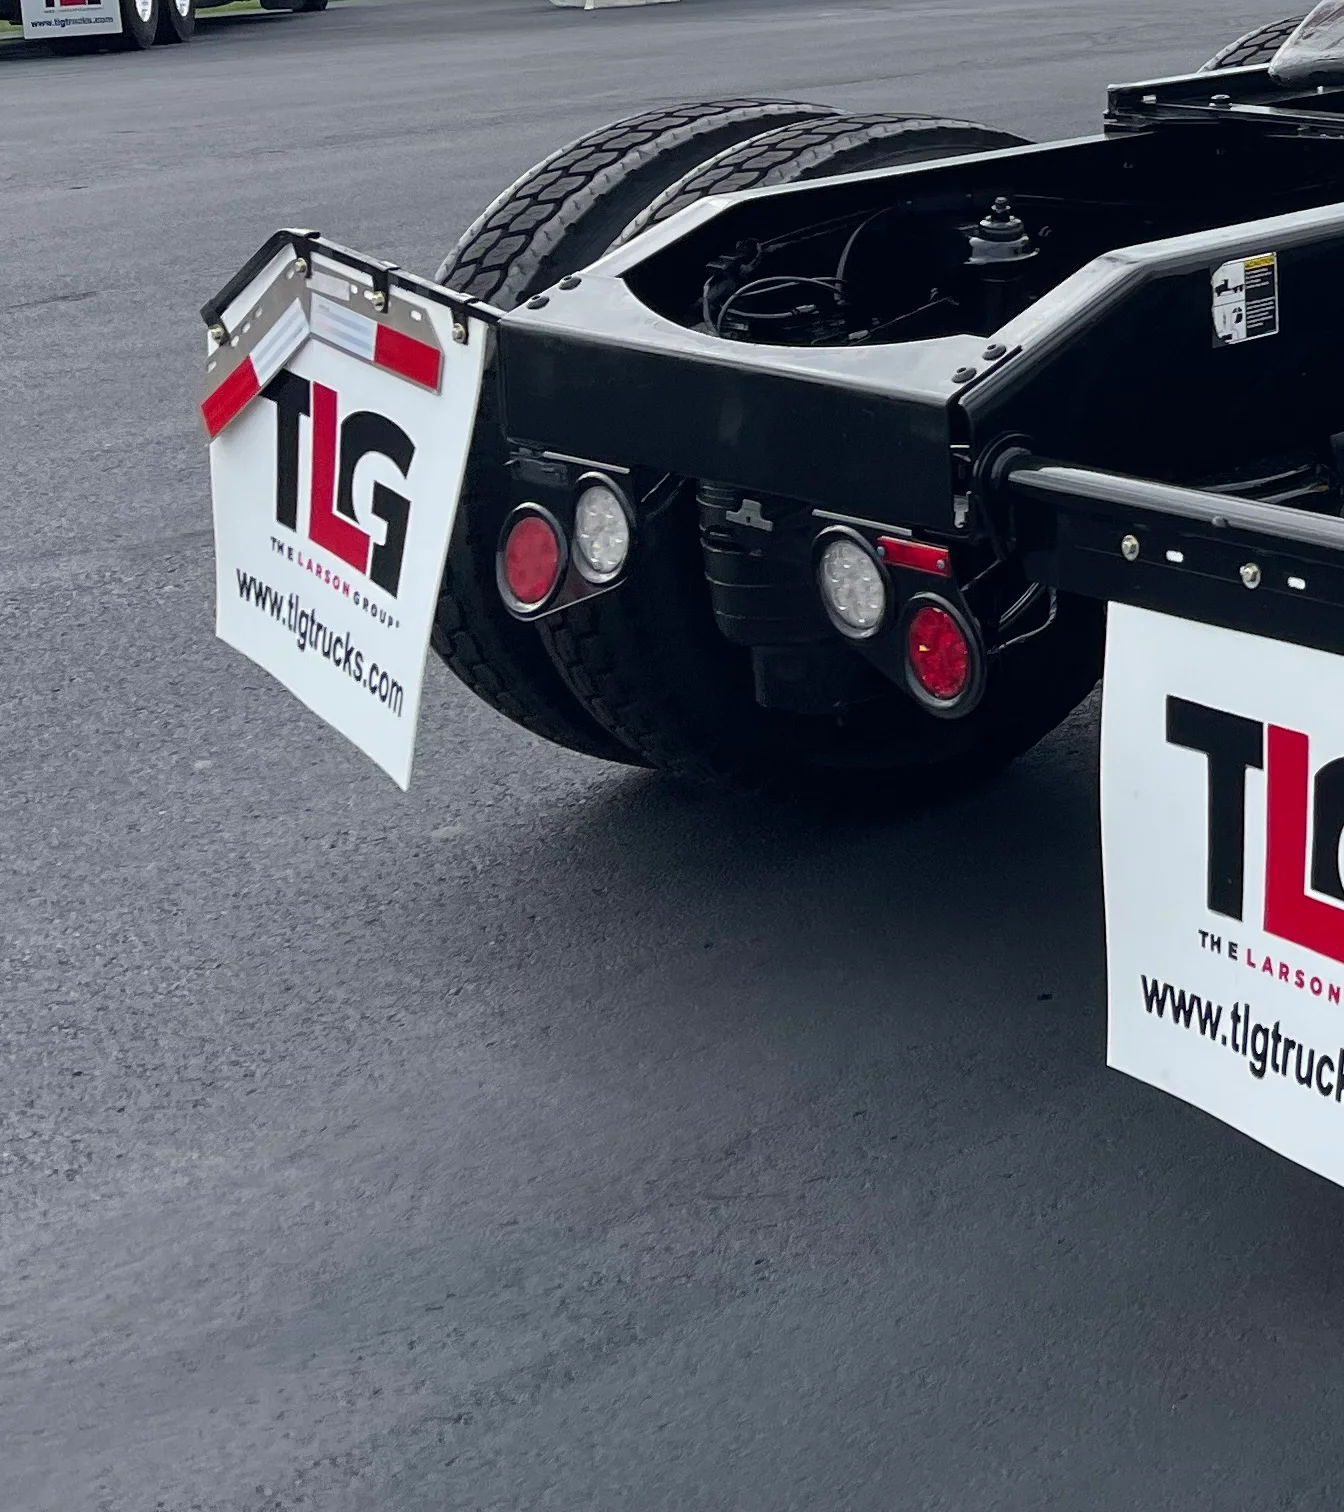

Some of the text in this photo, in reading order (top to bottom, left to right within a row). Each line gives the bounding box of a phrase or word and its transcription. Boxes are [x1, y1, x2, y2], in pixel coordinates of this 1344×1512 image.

[258, 369, 416, 600] TLG
[270, 536, 293, 562] THE
[297, 551, 351, 598] LARSON
[236, 568, 404, 718] www.tlgtrucks.com
[1198, 929, 1238, 961] THE
[1246, 948, 1341, 1004] LARSON
